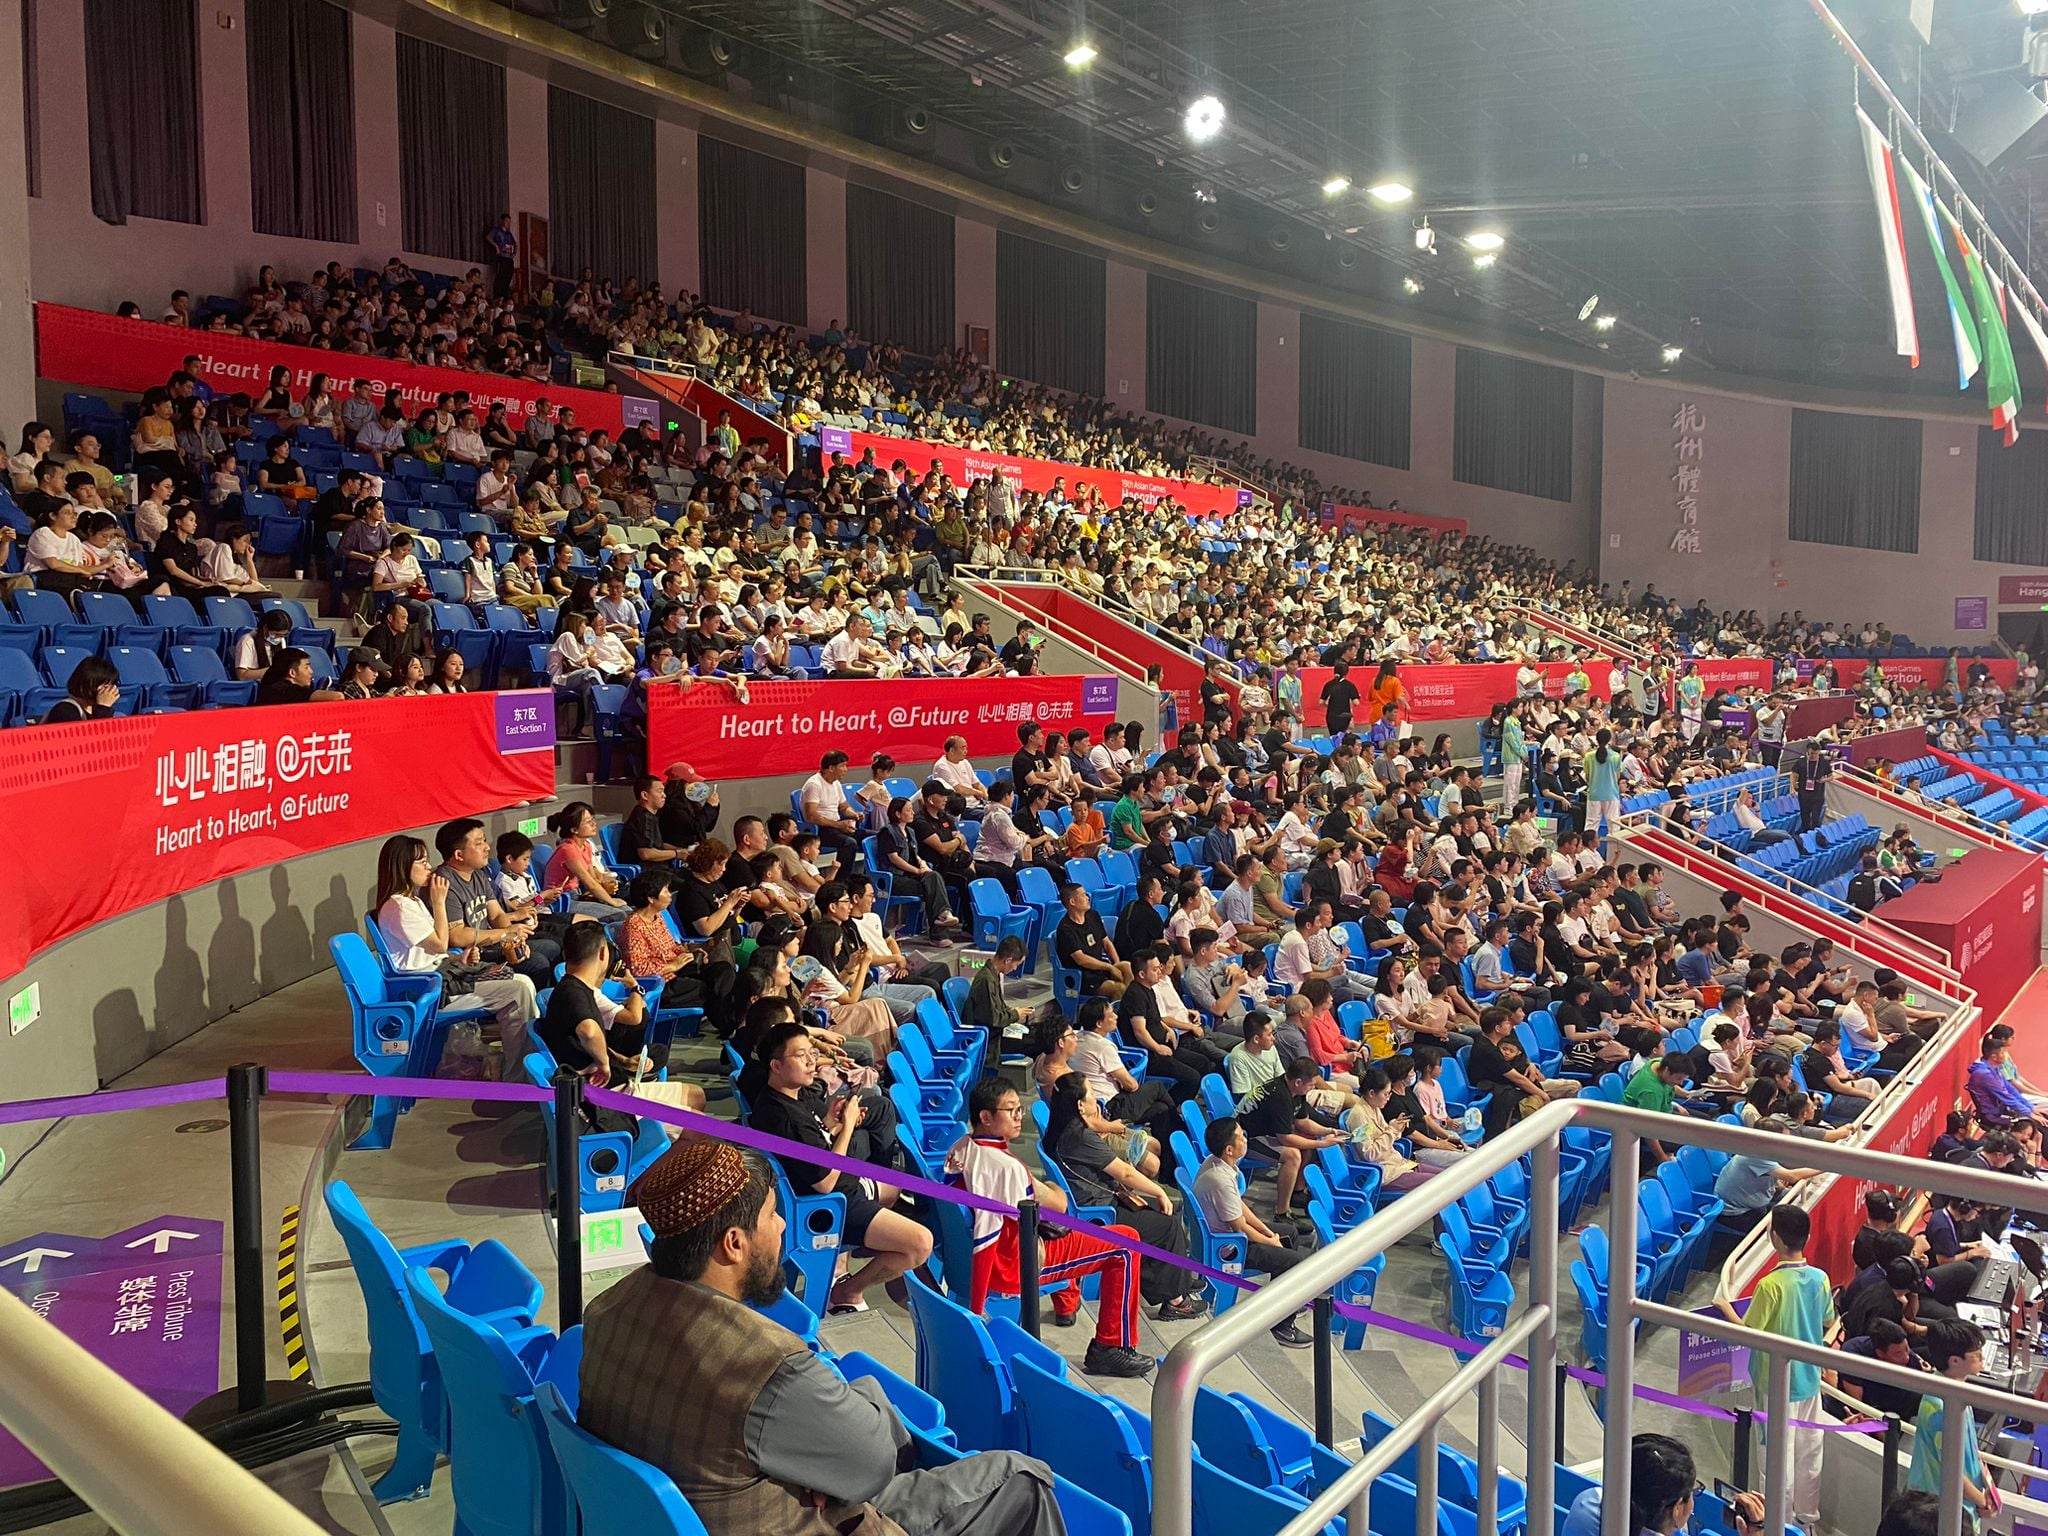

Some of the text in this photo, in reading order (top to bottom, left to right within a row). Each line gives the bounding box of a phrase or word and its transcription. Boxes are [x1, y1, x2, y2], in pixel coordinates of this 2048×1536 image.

[513, 707, 538, 721] 东7区
[720, 706, 970, 739] Heart to Heart, @Future
[506, 722, 547, 735] East Section 7
[156, 792, 350, 856] Heart to Heart, @Future
[393, 1041, 398, 1049] 9
[1911, 1095, 1938, 1140] @Future
[608, 1177, 614, 1186] 8
[109, 1275, 158, 1336] 媒体坐席
[162, 1269, 194, 1342] Press Tribune
[1688, 1351, 1711, 1362] Please
[1711, 1348, 1720, 1357] Sit
